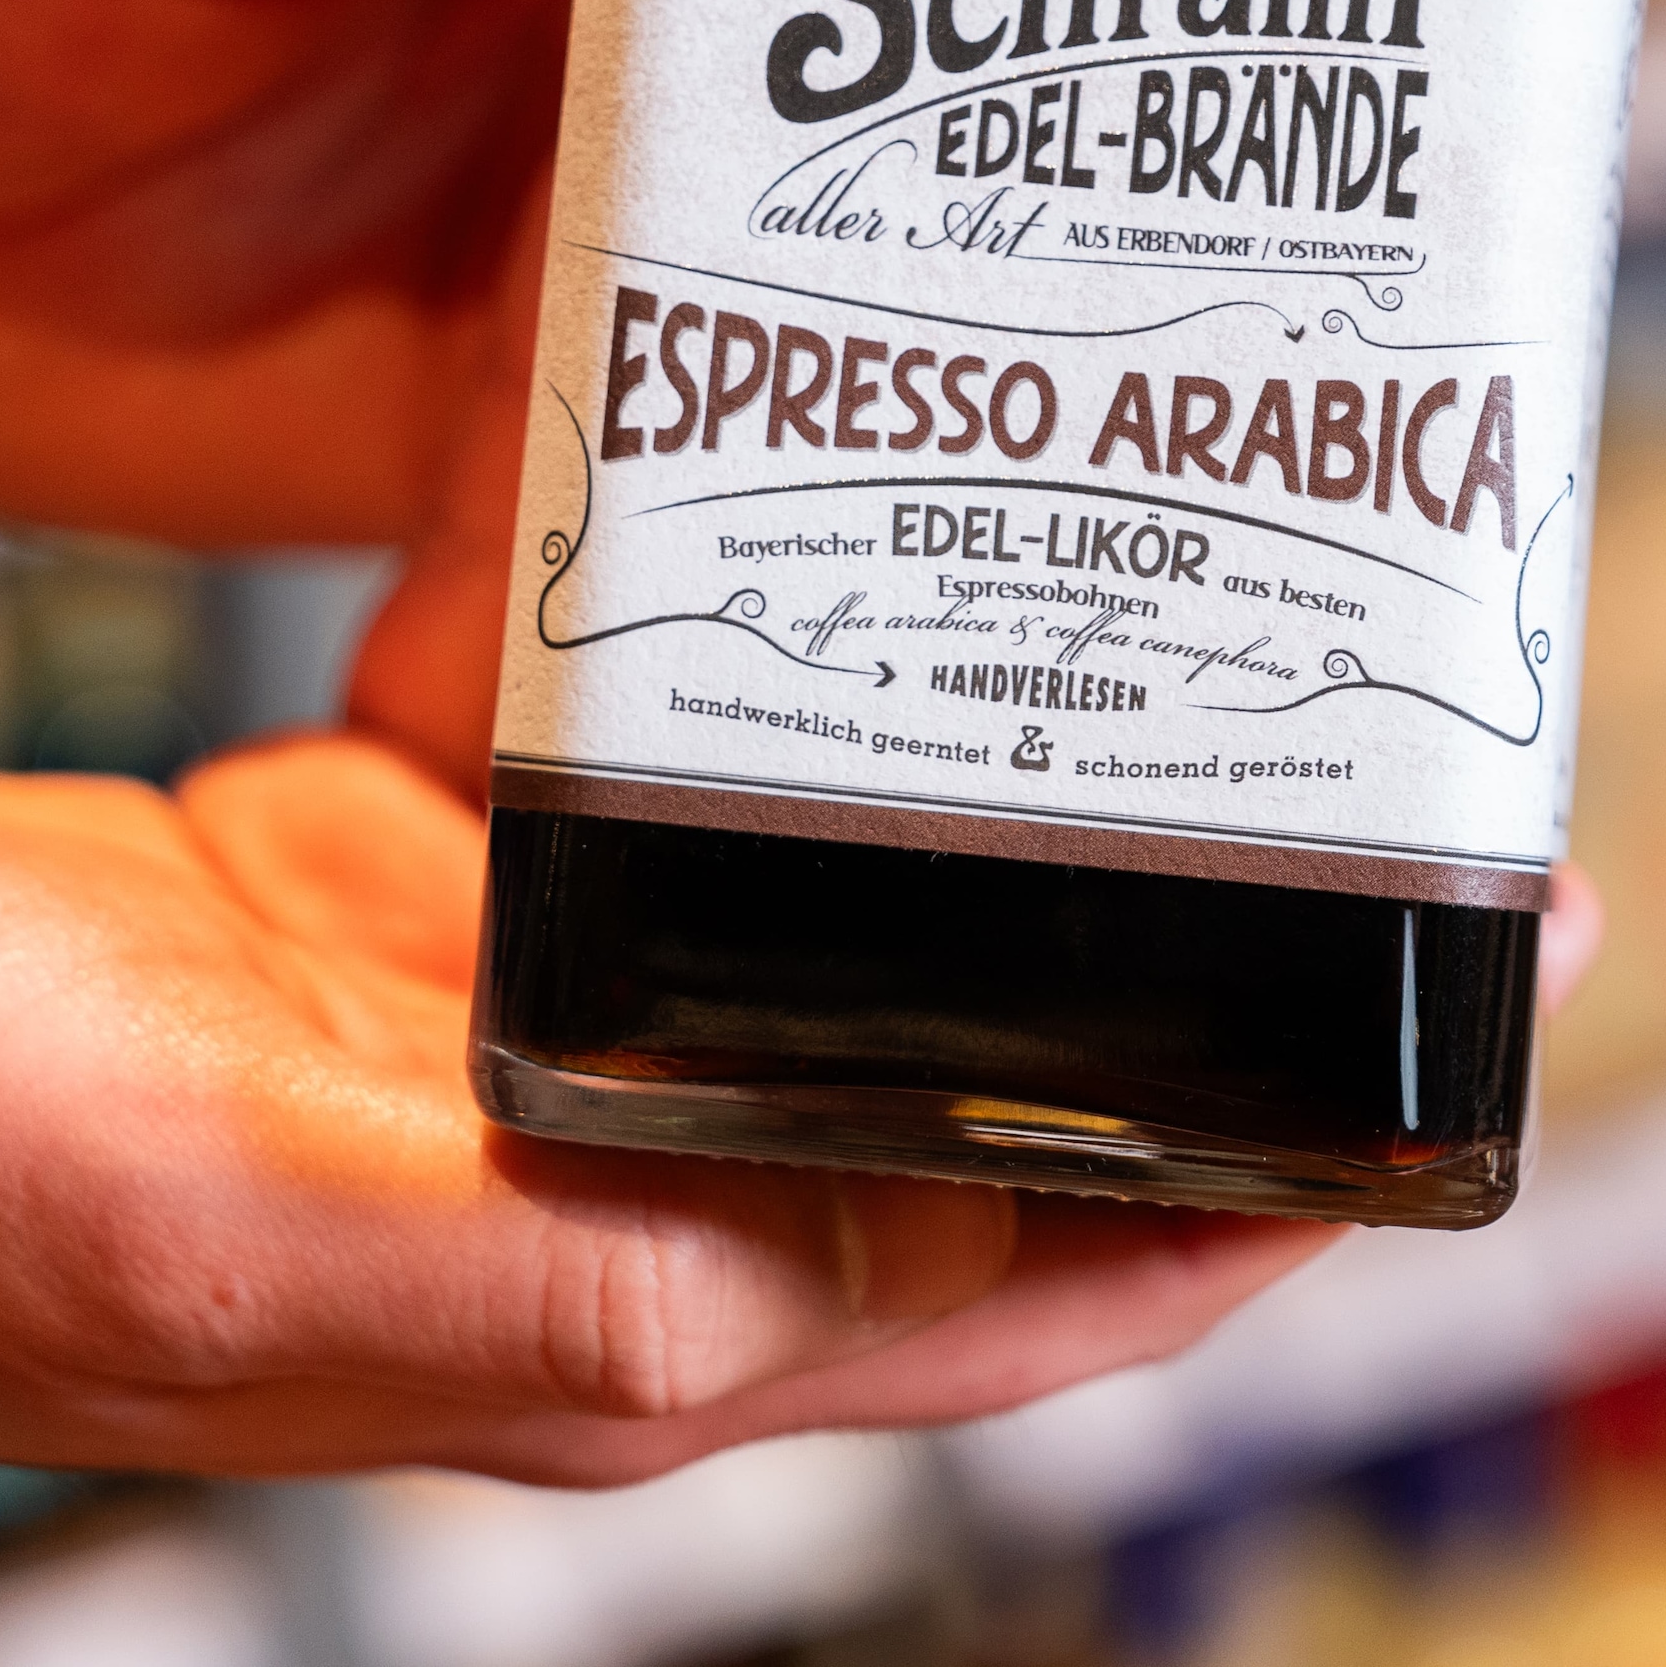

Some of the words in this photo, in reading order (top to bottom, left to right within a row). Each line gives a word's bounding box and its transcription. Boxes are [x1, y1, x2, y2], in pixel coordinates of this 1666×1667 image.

[935, 63, 1429, 221] EDEL-BRÄNDE
[758, 138, 919, 243] aller
[906, 186, 1049, 259] Art
[1063, 222, 1110, 250] AUS
[1117, 226, 1258, 258] ERBENDORF
[1261, 236, 1271, 261] /
[1278, 239, 1415, 263] OSTBAYERN
[599, 285, 1059, 463] ESPRESSO
[1087, 372, 1520, 553] ARABICA
[718, 532, 878, 564] Bayerischer
[891, 502, 1211, 587] EDEL-LIKÖR
[1222, 574, 1272, 599] aus
[1278, 578, 1368, 622] besten
[936, 574, 1160, 620] Espressobohnen
[790, 590, 877, 657] coffea
[884, 594, 1000, 633] arabica
[1009, 615, 1045, 646] &
[1044, 605, 1133, 666] coffea
[1138, 635, 1300, 685] canephora
[668, 688, 863, 745] handwerklich
[870, 732, 992, 767] geerntet
[1009, 724, 1055, 773] &
[1074, 755, 1220, 779] schonend
[1228, 755, 1355, 784] geröstet
[930, 663, 1148, 713] HANDVERLESEN
